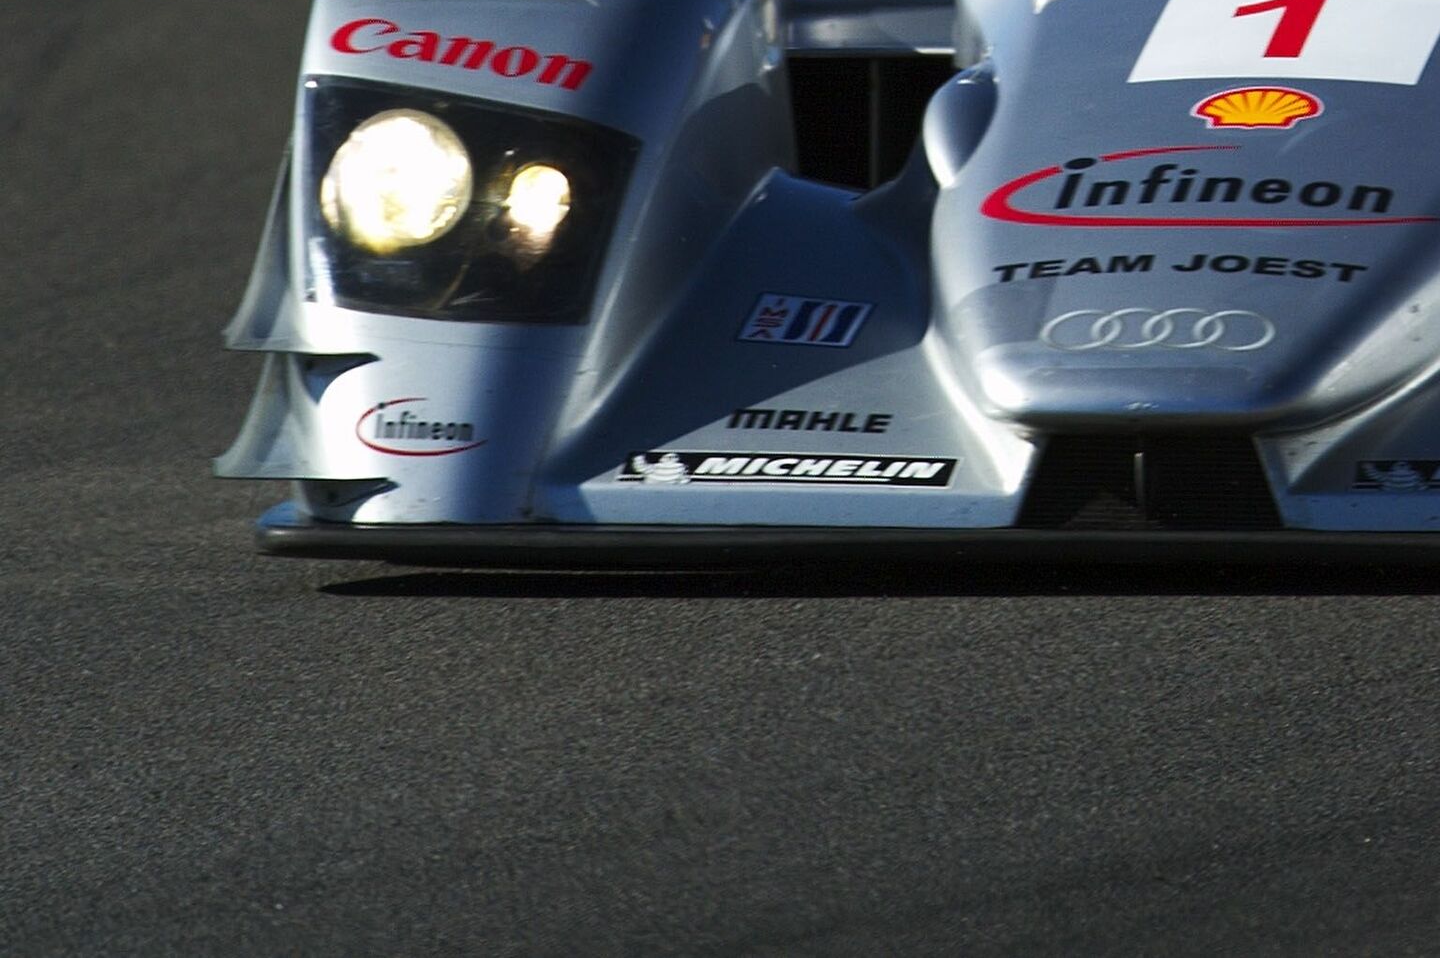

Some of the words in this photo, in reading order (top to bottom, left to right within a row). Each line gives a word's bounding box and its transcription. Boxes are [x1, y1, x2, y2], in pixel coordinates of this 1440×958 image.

[330, 17, 595, 91] Canon
[993, 254, 1155, 282] TEAM
[1172, 253, 1369, 283] JOEST
[726, 408, 894, 433] MAHLE
[693, 456, 947, 479] MICHELIN
